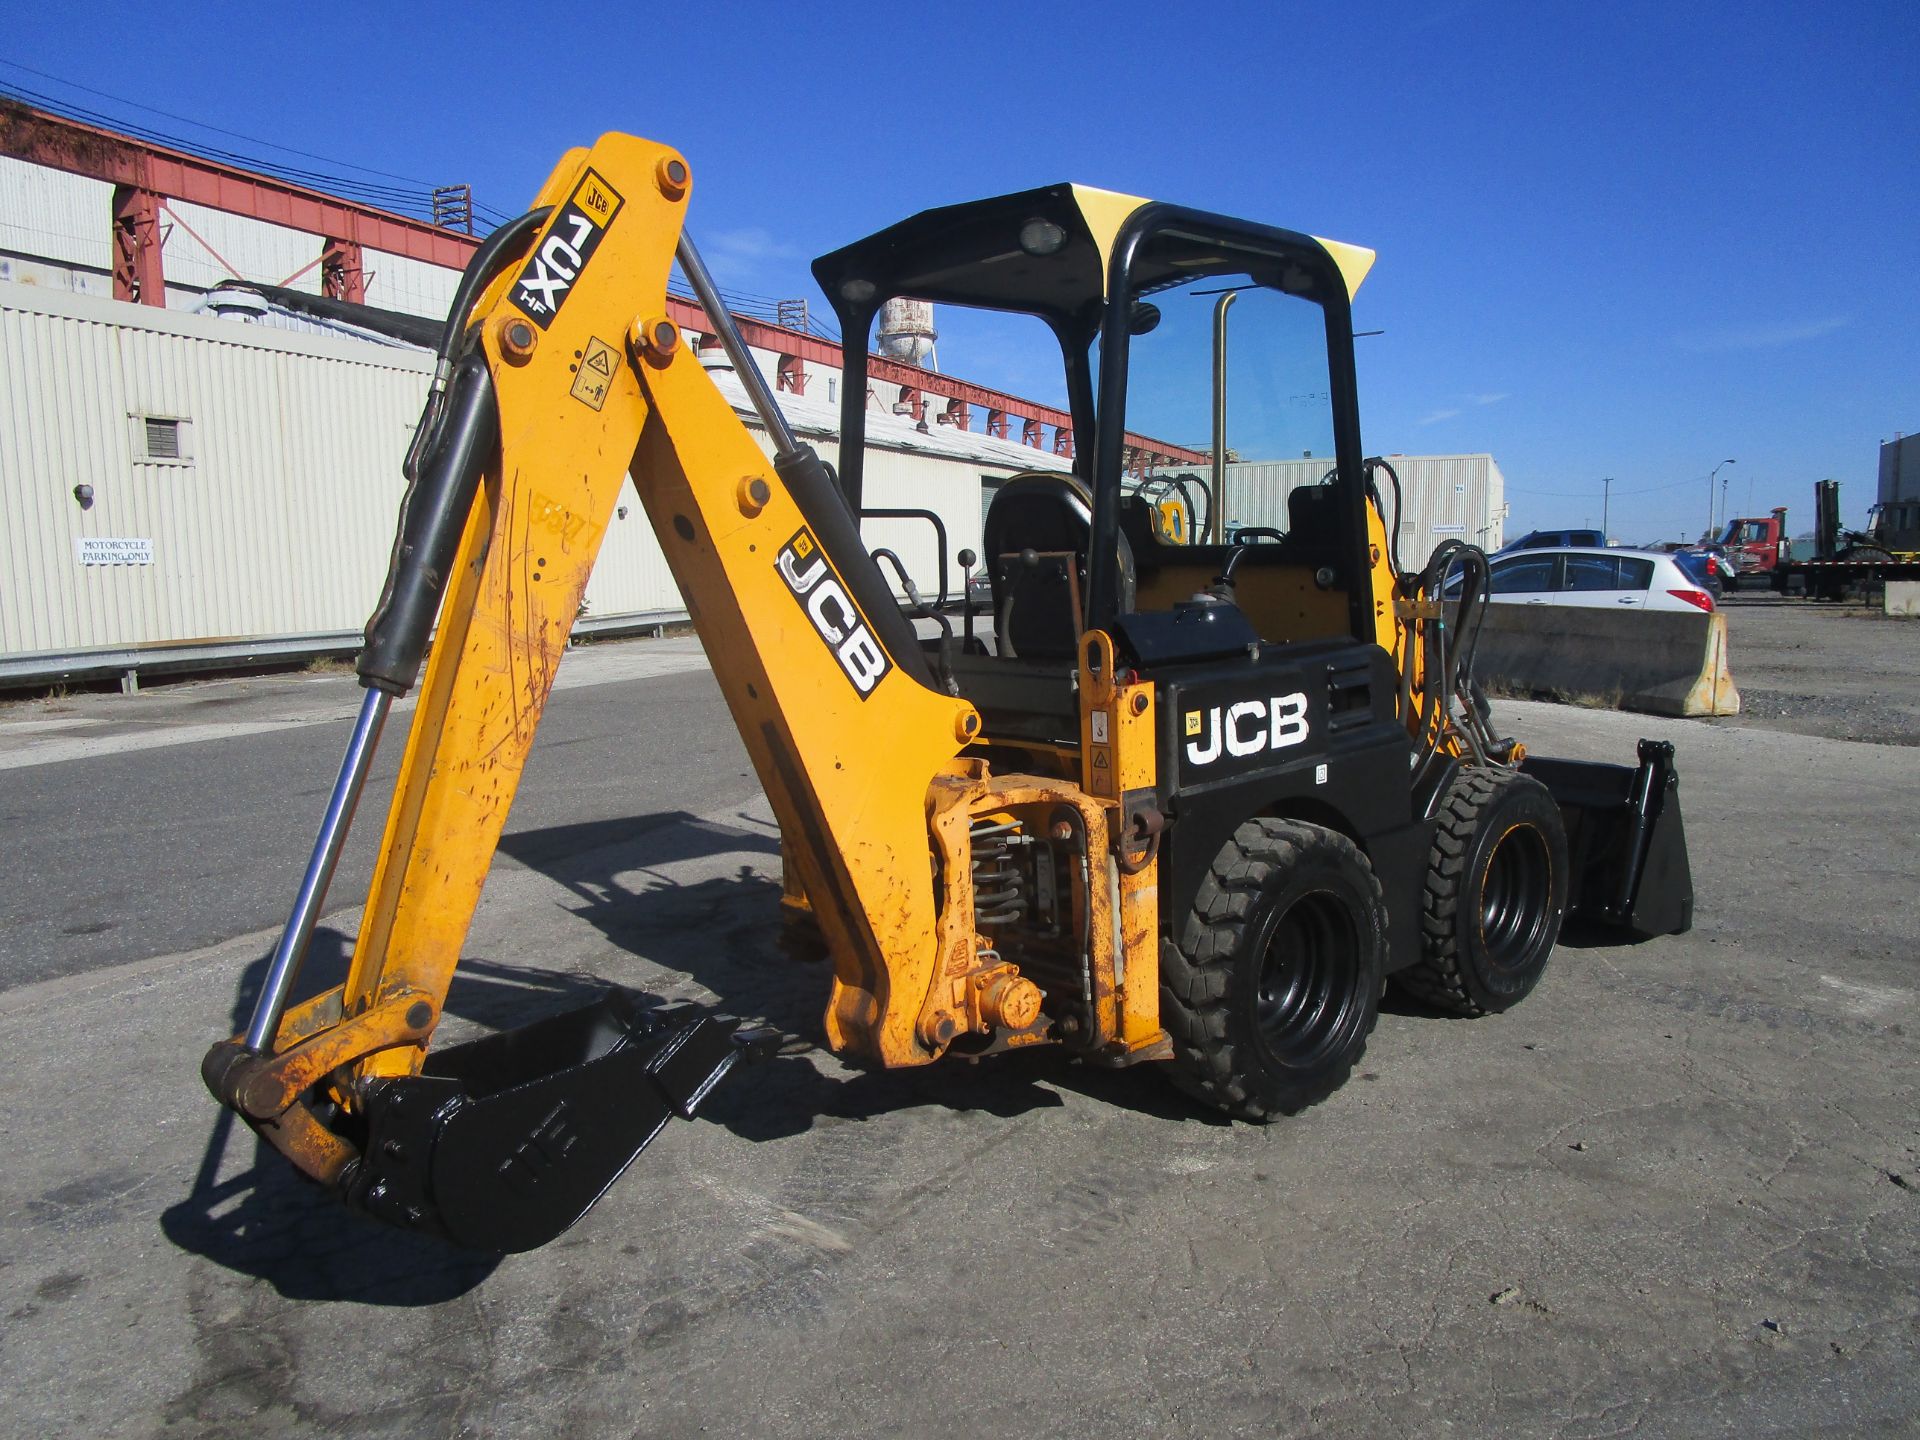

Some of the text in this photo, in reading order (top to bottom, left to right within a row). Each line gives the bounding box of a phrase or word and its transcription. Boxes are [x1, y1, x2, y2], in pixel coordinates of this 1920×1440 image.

[588, 187, 608, 214] JCB
[519, 214, 593, 313] 1CX
[520, 290, 547, 314] HF
[82, 552, 150, 561] PARKING ONLY
[84, 541, 146, 550] MOTORCYCLE
[779, 548, 885, 692] JCB
[1186, 692, 1310, 765] JCB
